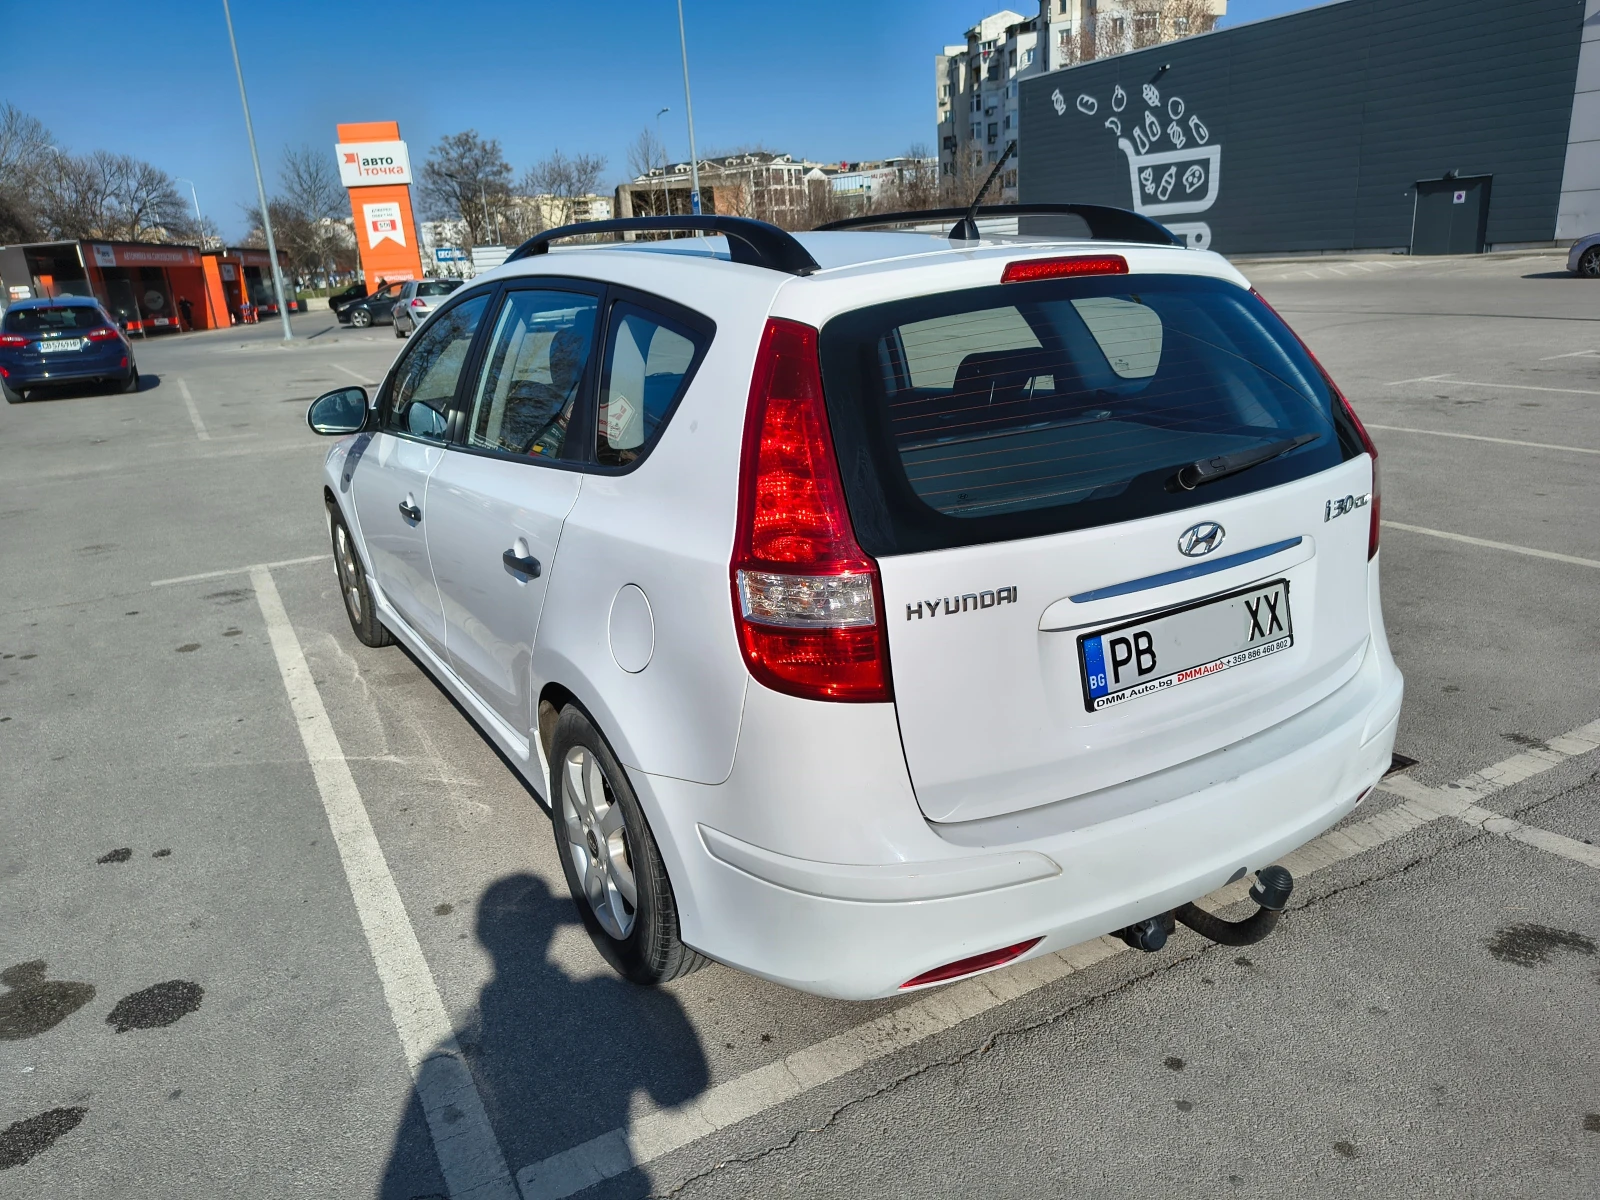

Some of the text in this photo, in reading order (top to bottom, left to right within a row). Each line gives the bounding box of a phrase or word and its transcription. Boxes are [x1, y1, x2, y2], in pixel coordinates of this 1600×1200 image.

[362, 157, 394, 167] авто
[364, 166, 404, 177] точка
[905, 585, 1018, 622] HYUNDAI
[1109, 591, 1283, 684] PB XX
[1176, 661, 1224, 683] DMMAuto
[1247, 648, 1261, 660] 886
[1262, 644, 1275, 655] 460
[1275, 639, 1288, 650] 802
[1089, 673, 1106, 690] BG
